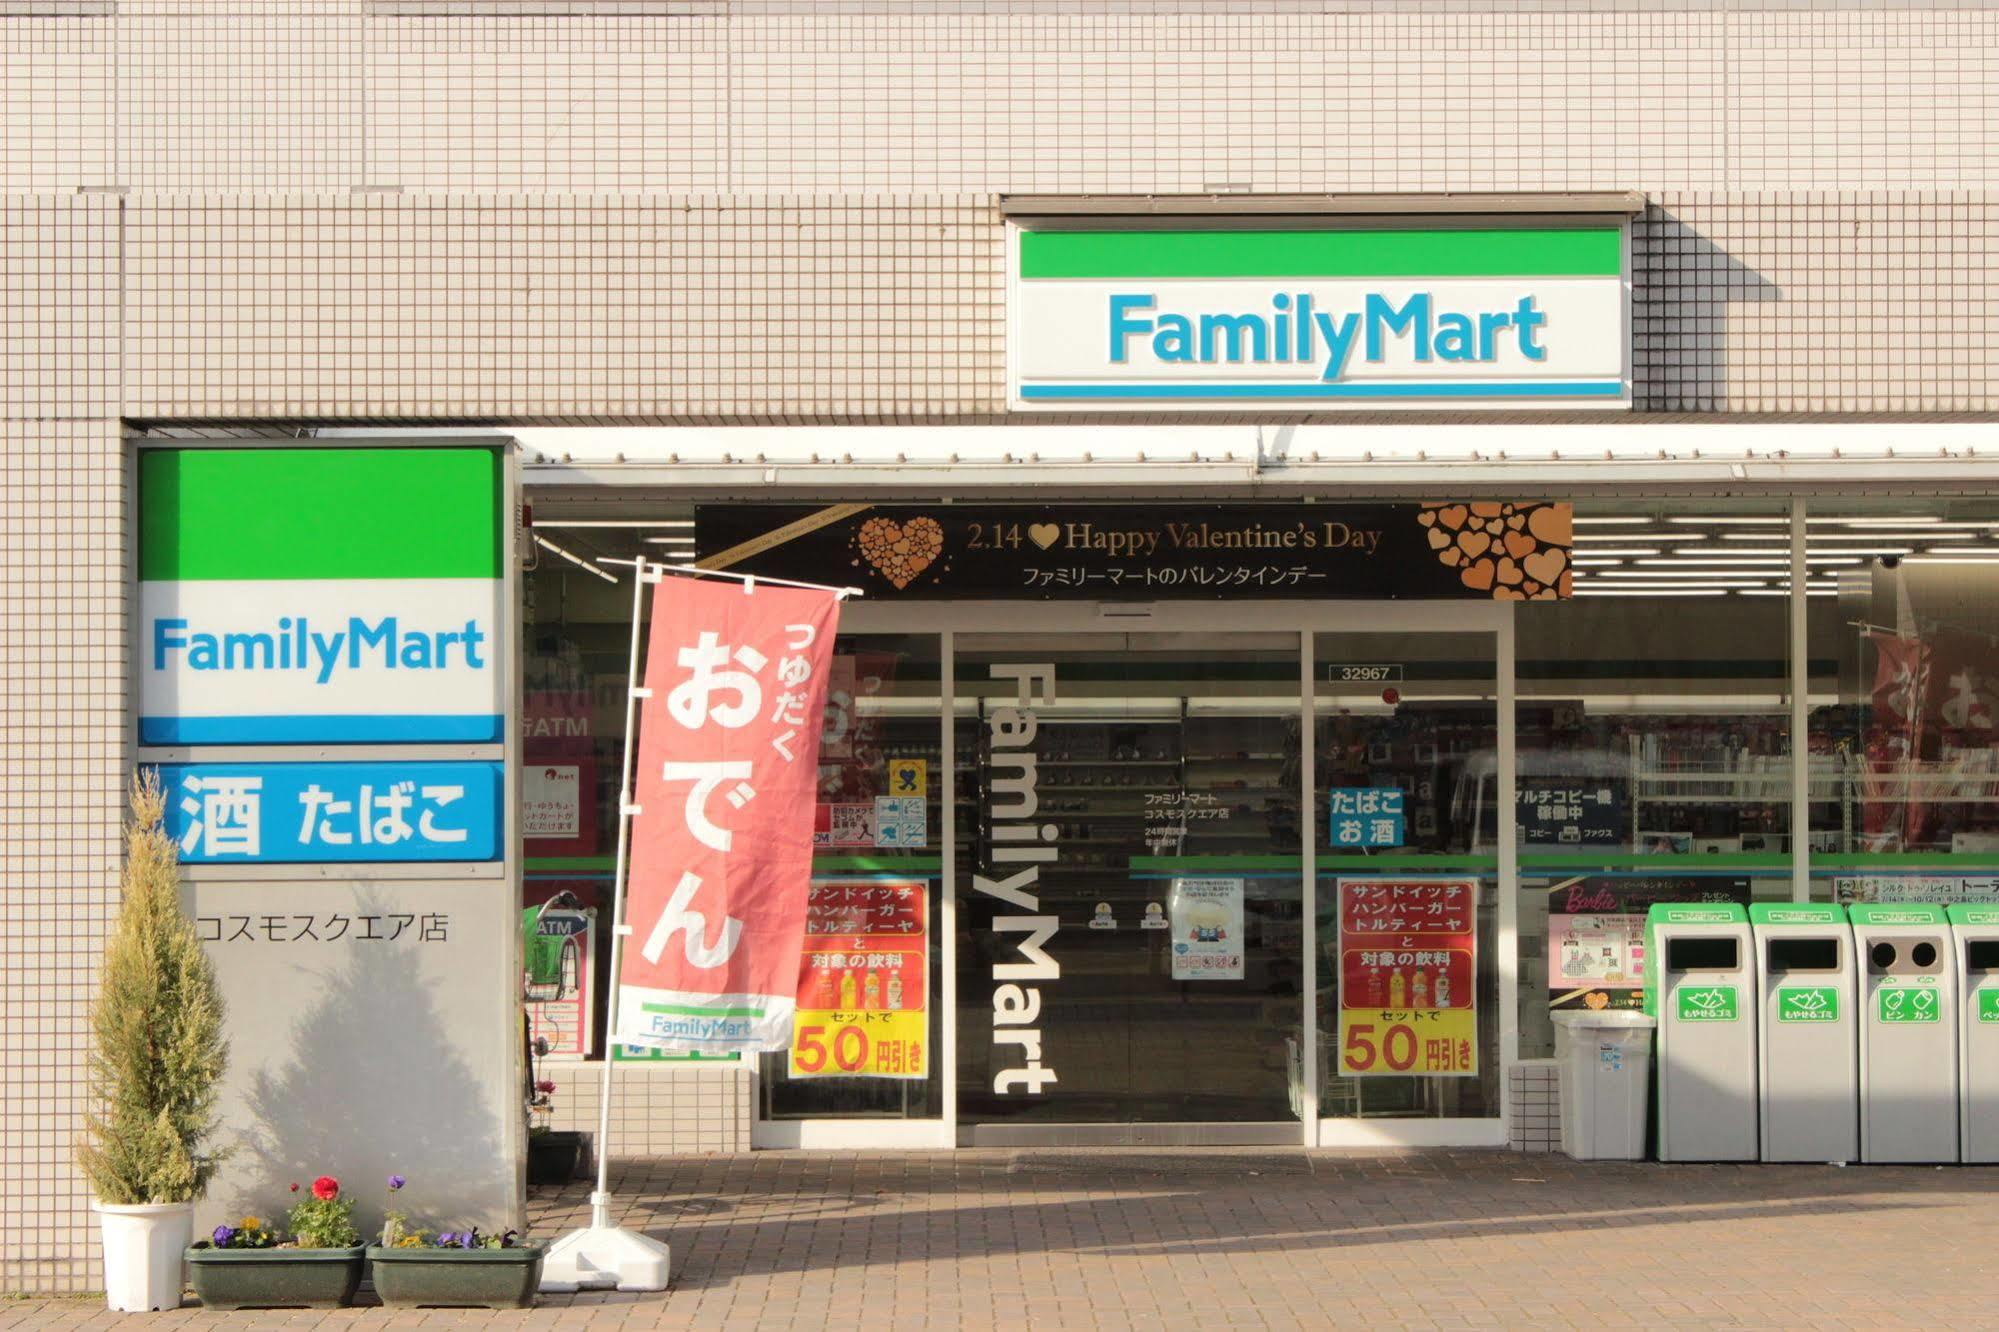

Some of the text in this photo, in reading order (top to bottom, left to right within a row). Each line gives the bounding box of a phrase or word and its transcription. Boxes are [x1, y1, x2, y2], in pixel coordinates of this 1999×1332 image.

[1109, 292, 1546, 381] FamilyMart
[967, 522, 1382, 556] 2.14 Happy Valentine's Day
[1023, 565, 1327, 587] ファミリーマートのバレンタインデー
[154, 616, 484, 684] FamilyMart
[1342, 667, 1390, 681] 32967
[770, 622, 817, 763] つゆだく
[641, 631, 769, 969] おでん
[1144, 793, 1218, 805] ファミリーマート
[1332, 790, 1402, 815] たばこ
[180, 775, 468, 857] 酒 たばこ
[1144, 807, 1230, 819] コスモスクエア店
[972, 663, 1061, 1095] FamilyMart
[1352, 885, 1463, 899] サンドイッチ
[1352, 901, 1462, 915] ハンバーガー
[197, 912, 450, 943] コスモスクエア店
[536, 920, 572, 935] ATM
[807, 919, 914, 933] トルティーヤ
[1354, 918, 1463, 932] トルティーヤ
[853, 936, 866, 949] と
[1401, 935, 1414, 948] と
[811, 953, 904, 969] 対象の飲料
[1360, 951, 1451, 967] 対象の飲料
[831, 1011, 893, 1023] セットで
[1380, 1010, 1441, 1022] セットで
[1683, 1007, 1733, 1019] もやせるゴミ
[1784, 1008, 1833, 1020] もやせるゴミ
[1914, 1011, 1934, 1020] カン
[652, 1015, 752, 1038] FamilyMart
